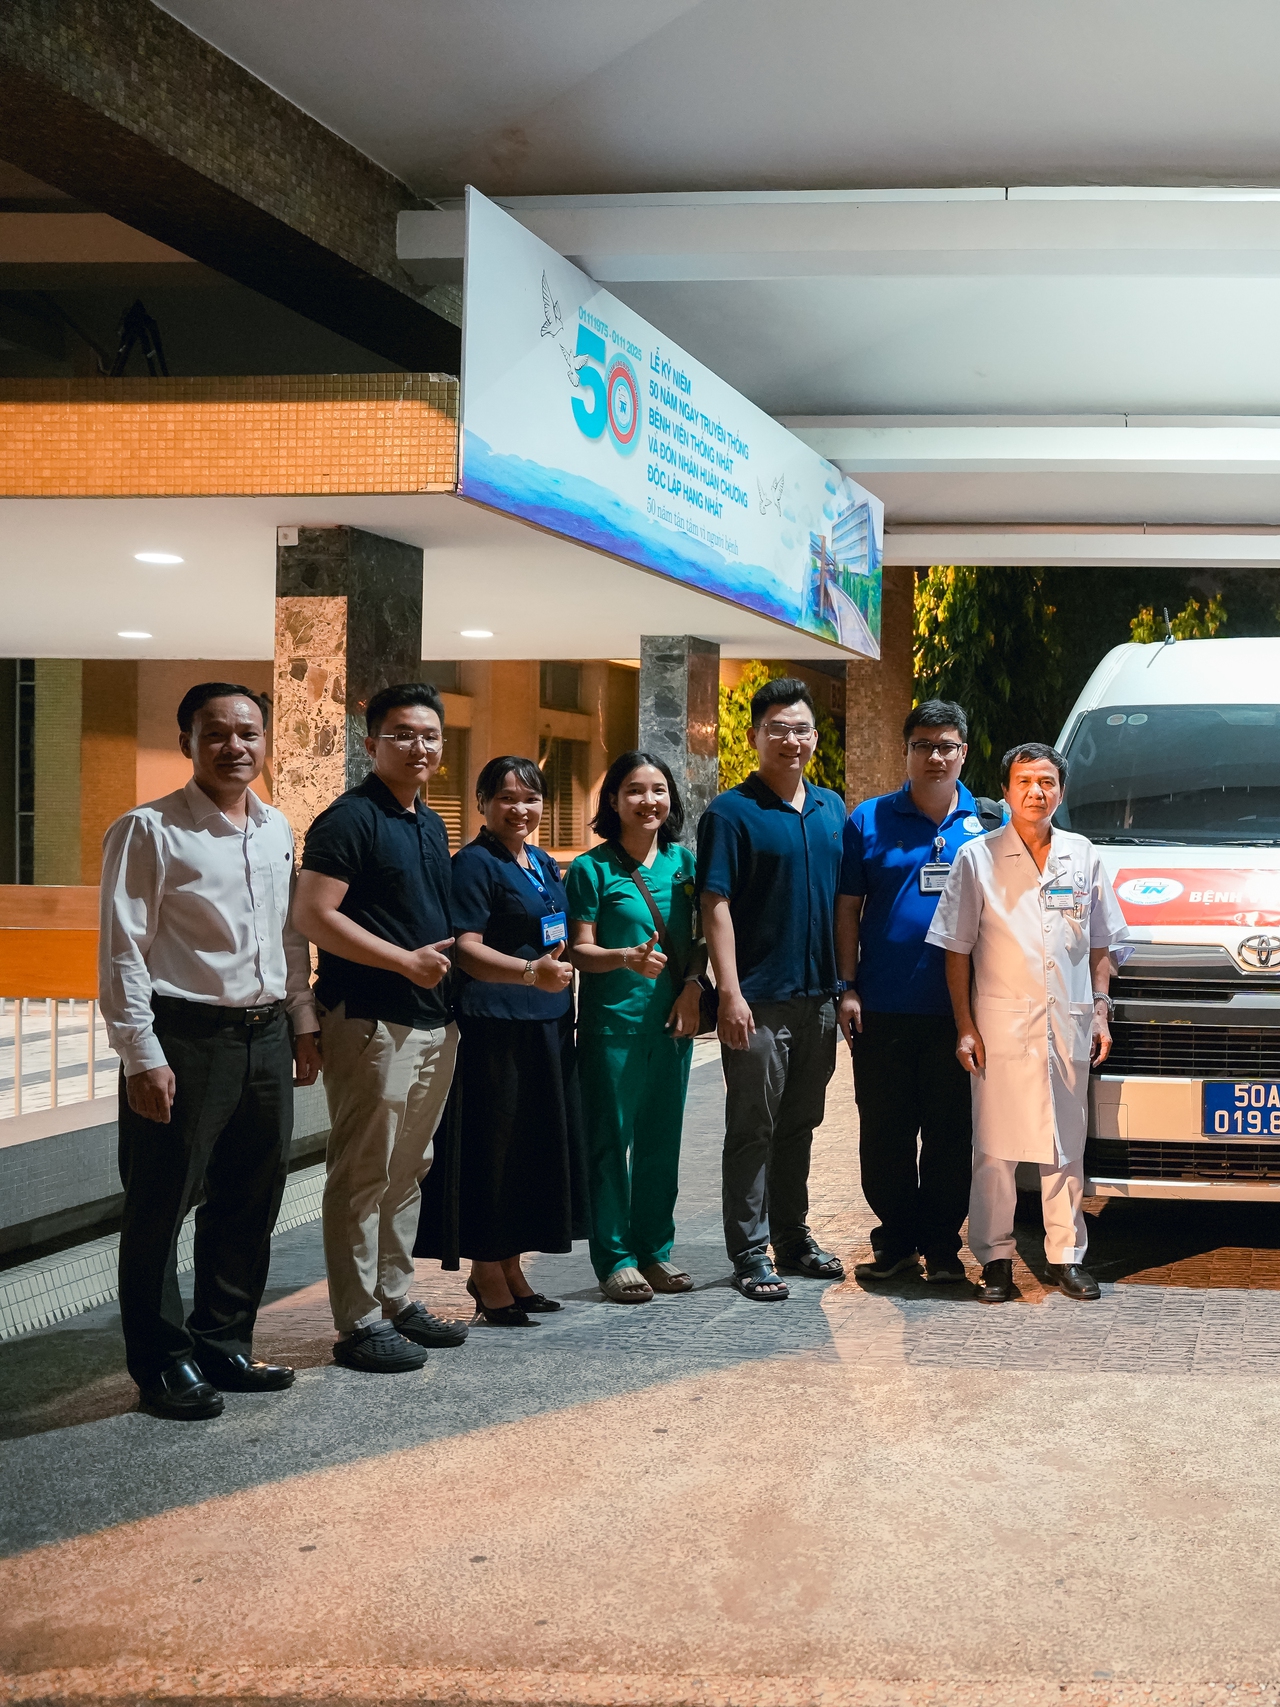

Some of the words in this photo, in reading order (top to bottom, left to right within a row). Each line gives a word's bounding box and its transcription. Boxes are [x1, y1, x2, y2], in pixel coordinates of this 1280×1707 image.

[650, 347, 660, 374] LỄ
[673, 370, 691, 395] NIỆM
[649, 379, 658, 400] 50
[660, 386, 677, 412] NĂM
[679, 402, 699, 426] NGÀY
[700, 413, 726, 444] TRUYỀN
[727, 430, 749, 460] THỐNG
[649, 406, 670, 437] BỆNH
[672, 422, 689, 448] VIỆN
[690, 432, 714, 463] THỐNG
[716, 448, 733, 474] NHẤT
[647, 463, 666, 490] ĐỘC
[668, 473, 681, 499] LẬP
[683, 484, 703, 509] HẠNG
[705, 492, 723, 519] NHẤT
[648, 433, 658, 457] VÀ
[660, 442, 676, 467] ĐÓN
[678, 453, 698, 481] NHẬN
[700, 466, 719, 491] HUÂN
[720, 479, 748, 508] CHƯƠNG
[647, 497, 656, 515] 50
[657, 506, 672, 523] năm
[674, 511, 684, 530] tận
[686, 518, 698, 536] tâm
[707, 531, 724, 548] người
[725, 535, 738, 555] bệnh
[1189, 890, 1243, 905] BỆNH
[1234, 1084, 1280, 1107] 50A
